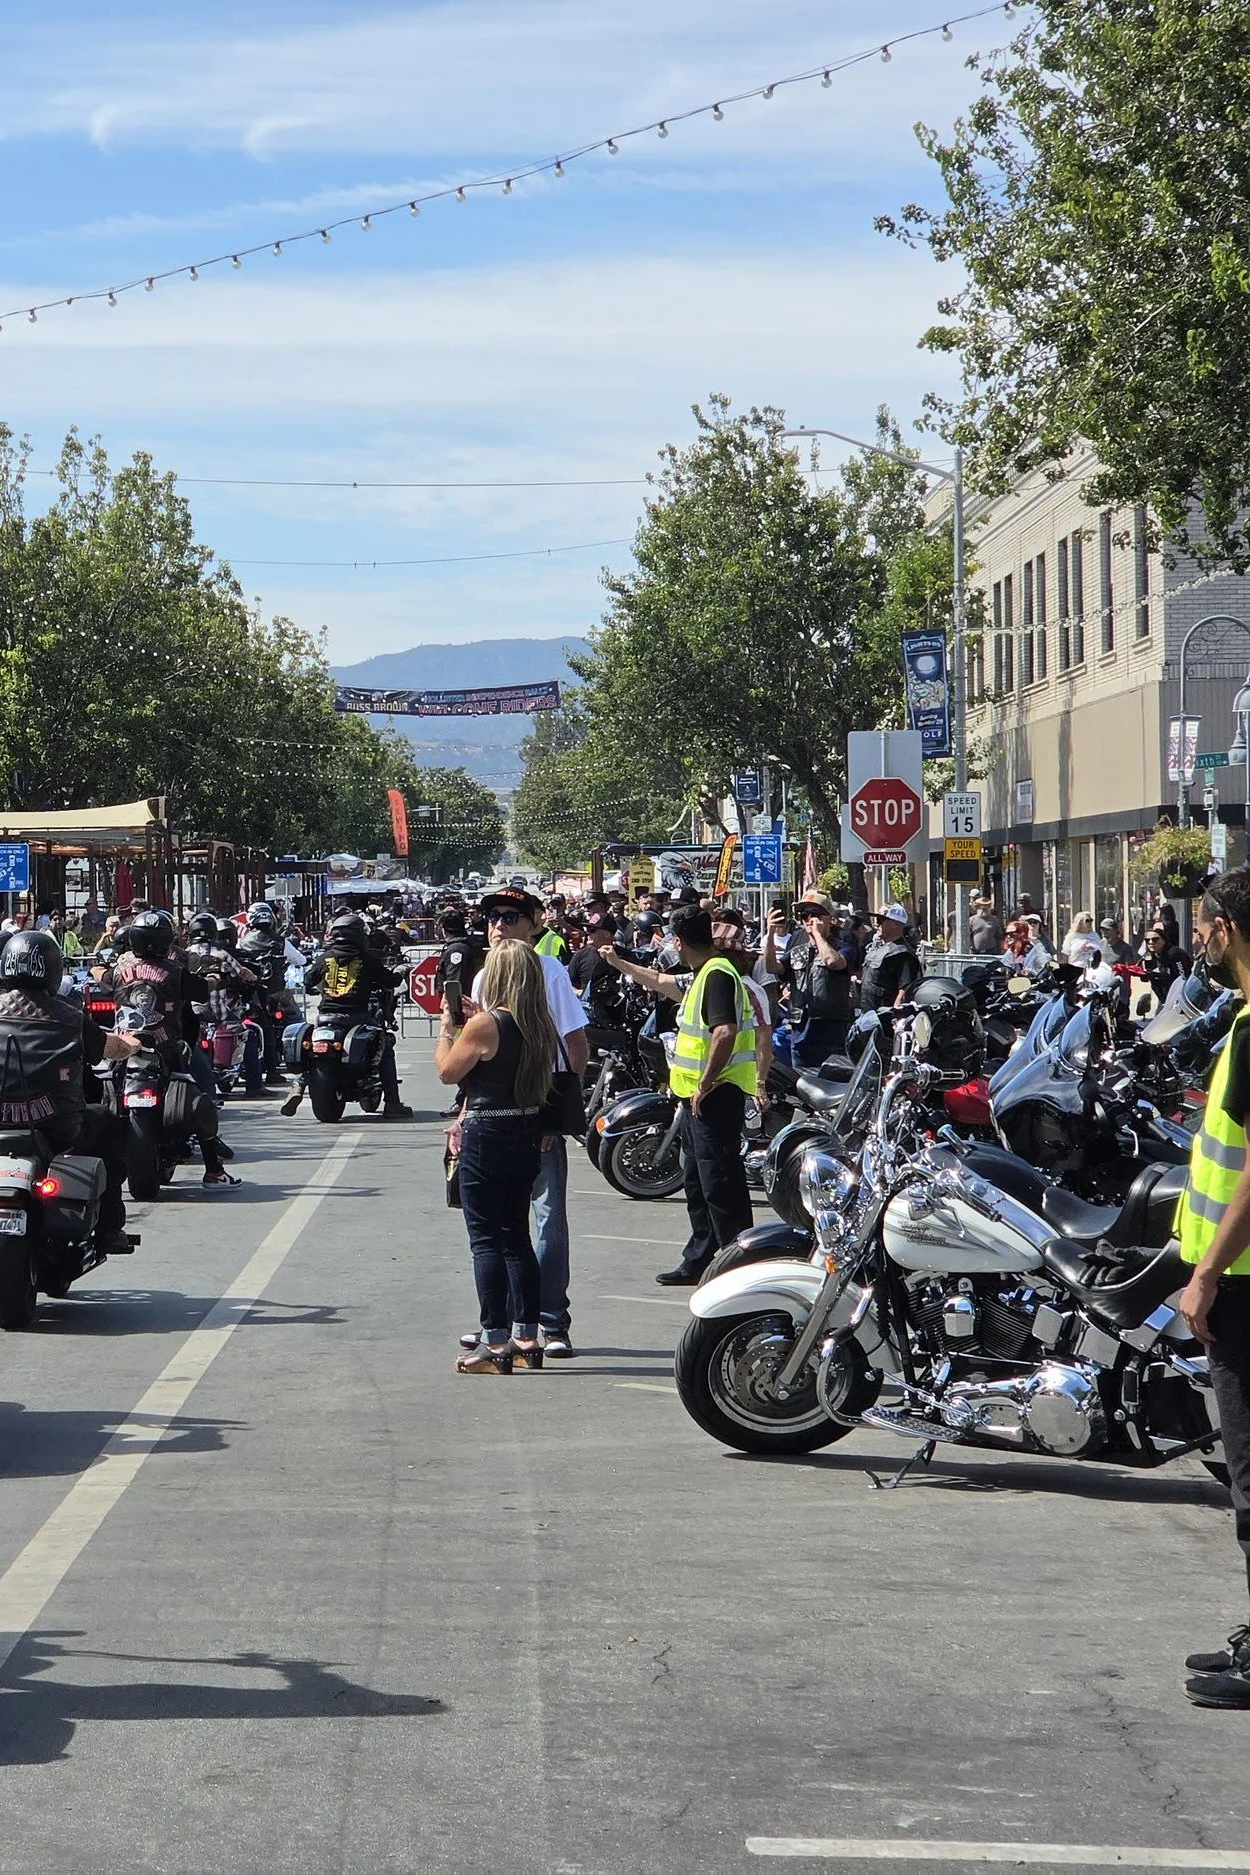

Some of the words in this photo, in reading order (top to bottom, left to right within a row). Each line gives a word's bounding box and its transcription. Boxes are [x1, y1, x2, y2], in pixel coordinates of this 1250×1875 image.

[500, 695, 556, 713] RIDERS
[923, 730, 943, 738] OLF
[1196, 757, 1215, 768] ixth
[947, 797, 977, 805] SPEED
[855, 799, 915, 826] STOP
[952, 817, 974, 833] 15
[952, 841, 974, 849] YOUR
[867, 853, 884, 863] ALL
[885, 852, 903, 863] WAY
[950, 850, 976, 858] SPEED
[414, 974, 437, 996] ST
